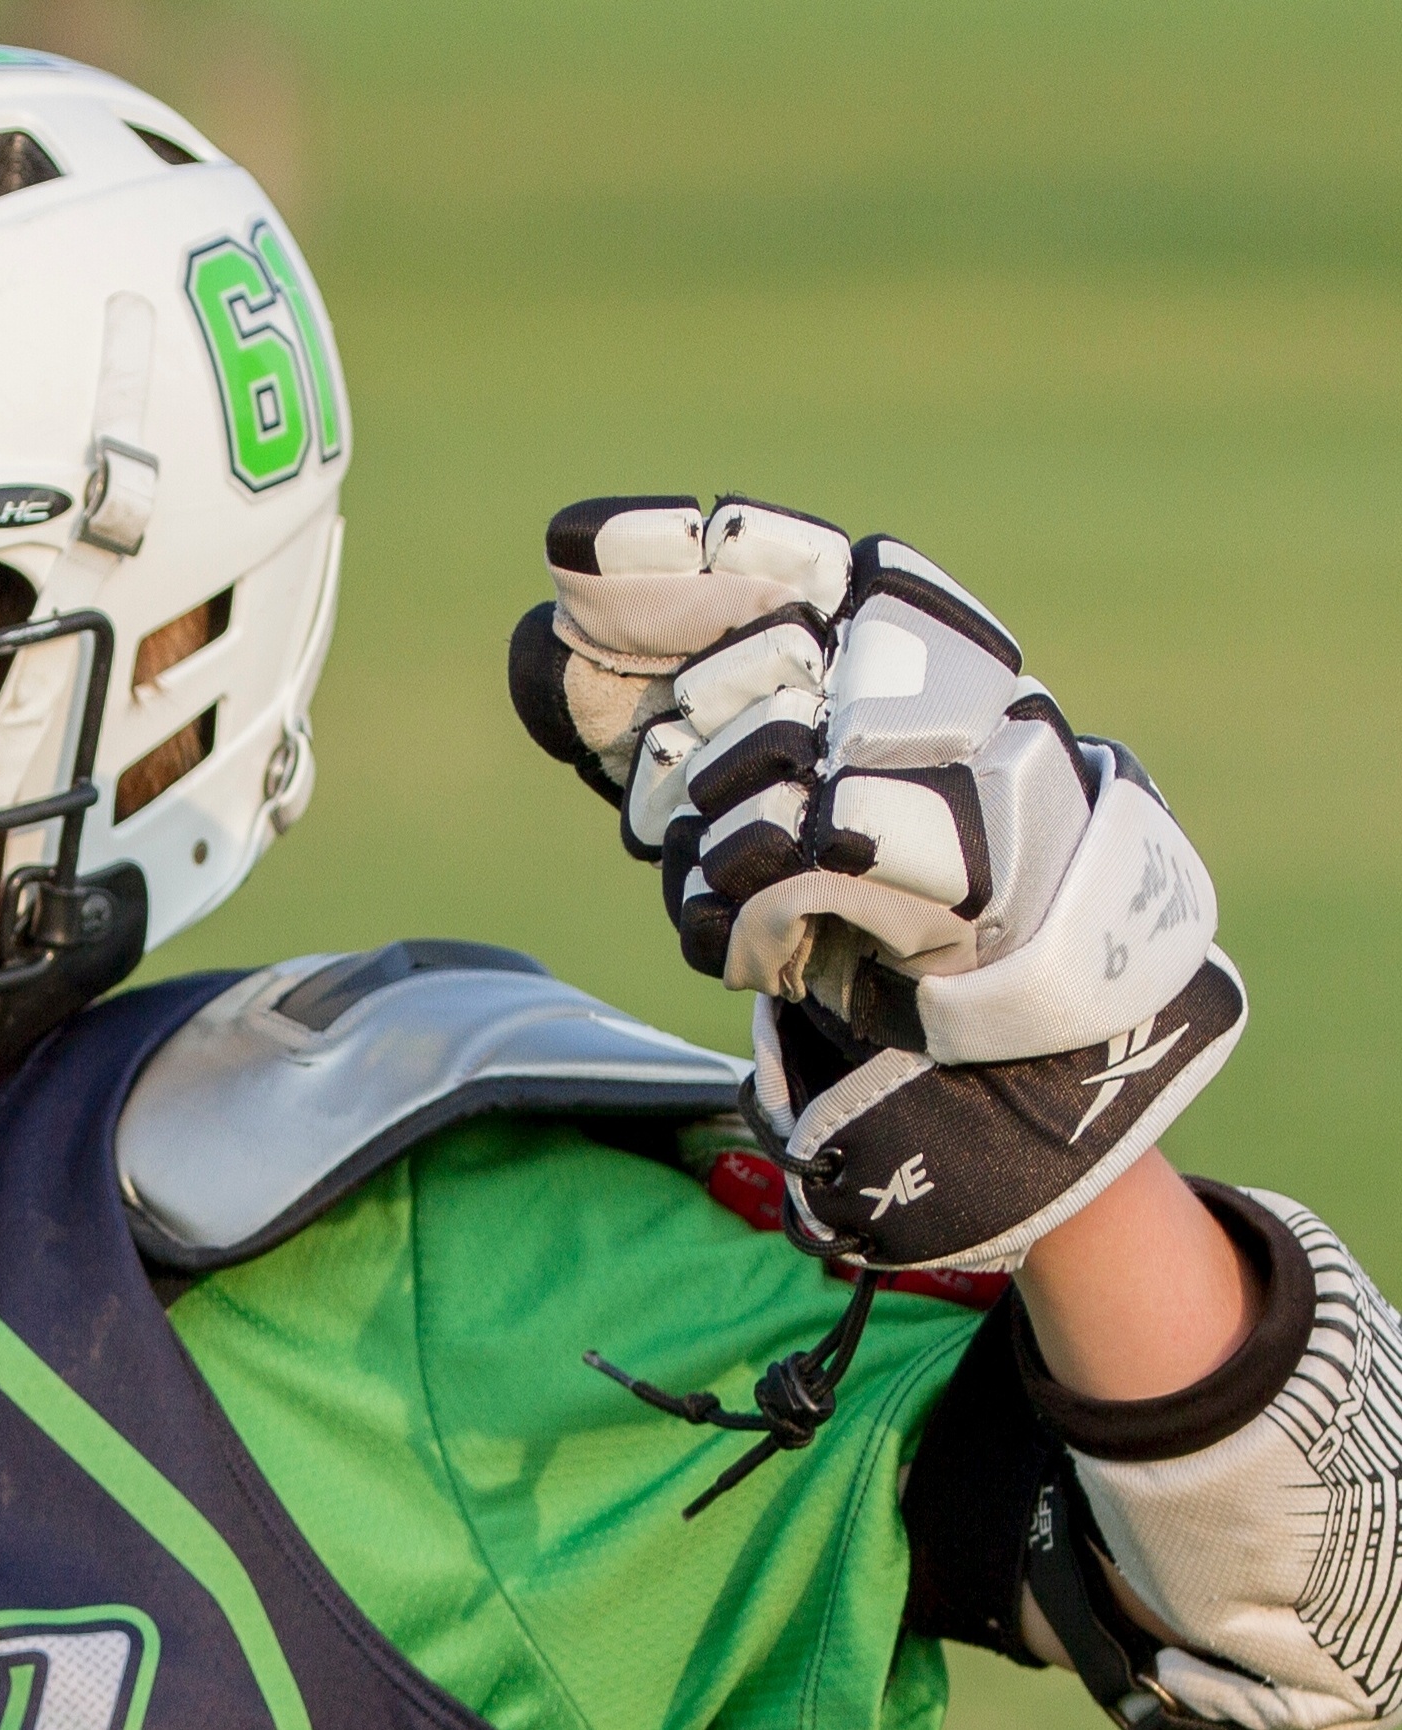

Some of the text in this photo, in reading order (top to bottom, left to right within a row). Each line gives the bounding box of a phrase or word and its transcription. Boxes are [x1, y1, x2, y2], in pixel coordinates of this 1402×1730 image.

[183, 219, 341, 493] 61
[1306, 1276, 1374, 1474] RISING
[1038, 1483, 1055, 1551] LEFT
